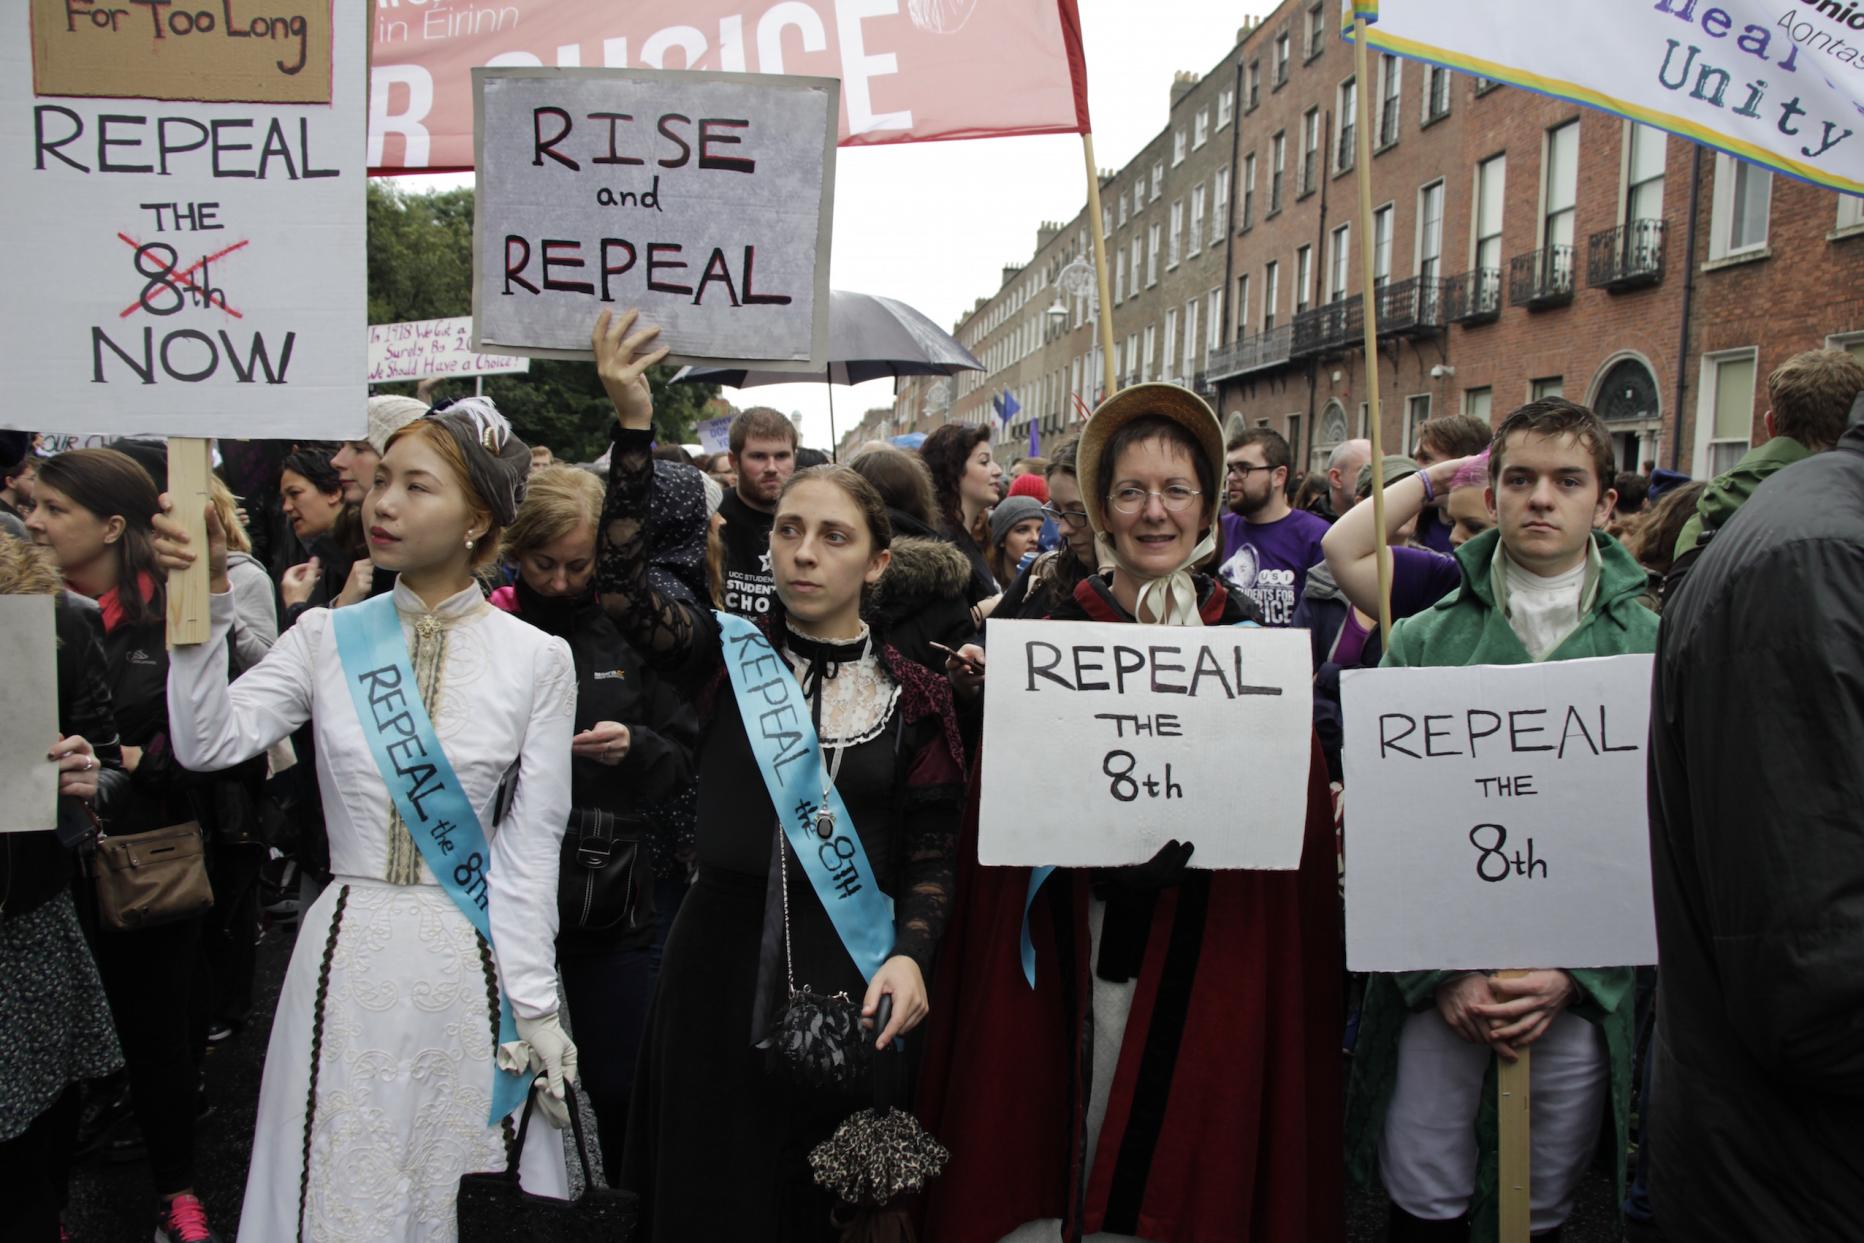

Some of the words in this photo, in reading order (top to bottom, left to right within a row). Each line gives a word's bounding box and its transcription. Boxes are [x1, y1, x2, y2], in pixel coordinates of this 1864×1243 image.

[66, 0, 129, 32] For
[130, 0, 215, 39] Too
[223, 0, 307, 75] Long
[379, 16, 408, 43] in
[423, 3, 519, 40] Éirinn
[1658, 38, 1853, 157] Unity
[33, 104, 341, 180] REPEAL
[531, 106, 756, 174] RISE
[140, 202, 225, 232] THE
[596, 175, 663, 212] and
[134, 242, 226, 316] 8th
[501, 234, 793, 308] REPEAL
[90, 326, 297, 385] NOW
[1025, 641, 1283, 699] REPEAL
[730, 632, 810, 788] REPEAL
[1094, 713, 1183, 738] THE
[1379, 704, 1640, 759] REPEAL
[358, 663, 445, 823] REPEAL
[430, 818, 457, 857] the
[1103, 749, 1183, 802] 8th
[1475, 775, 1539, 798] THE
[1469, 823, 1548, 882] 8th
